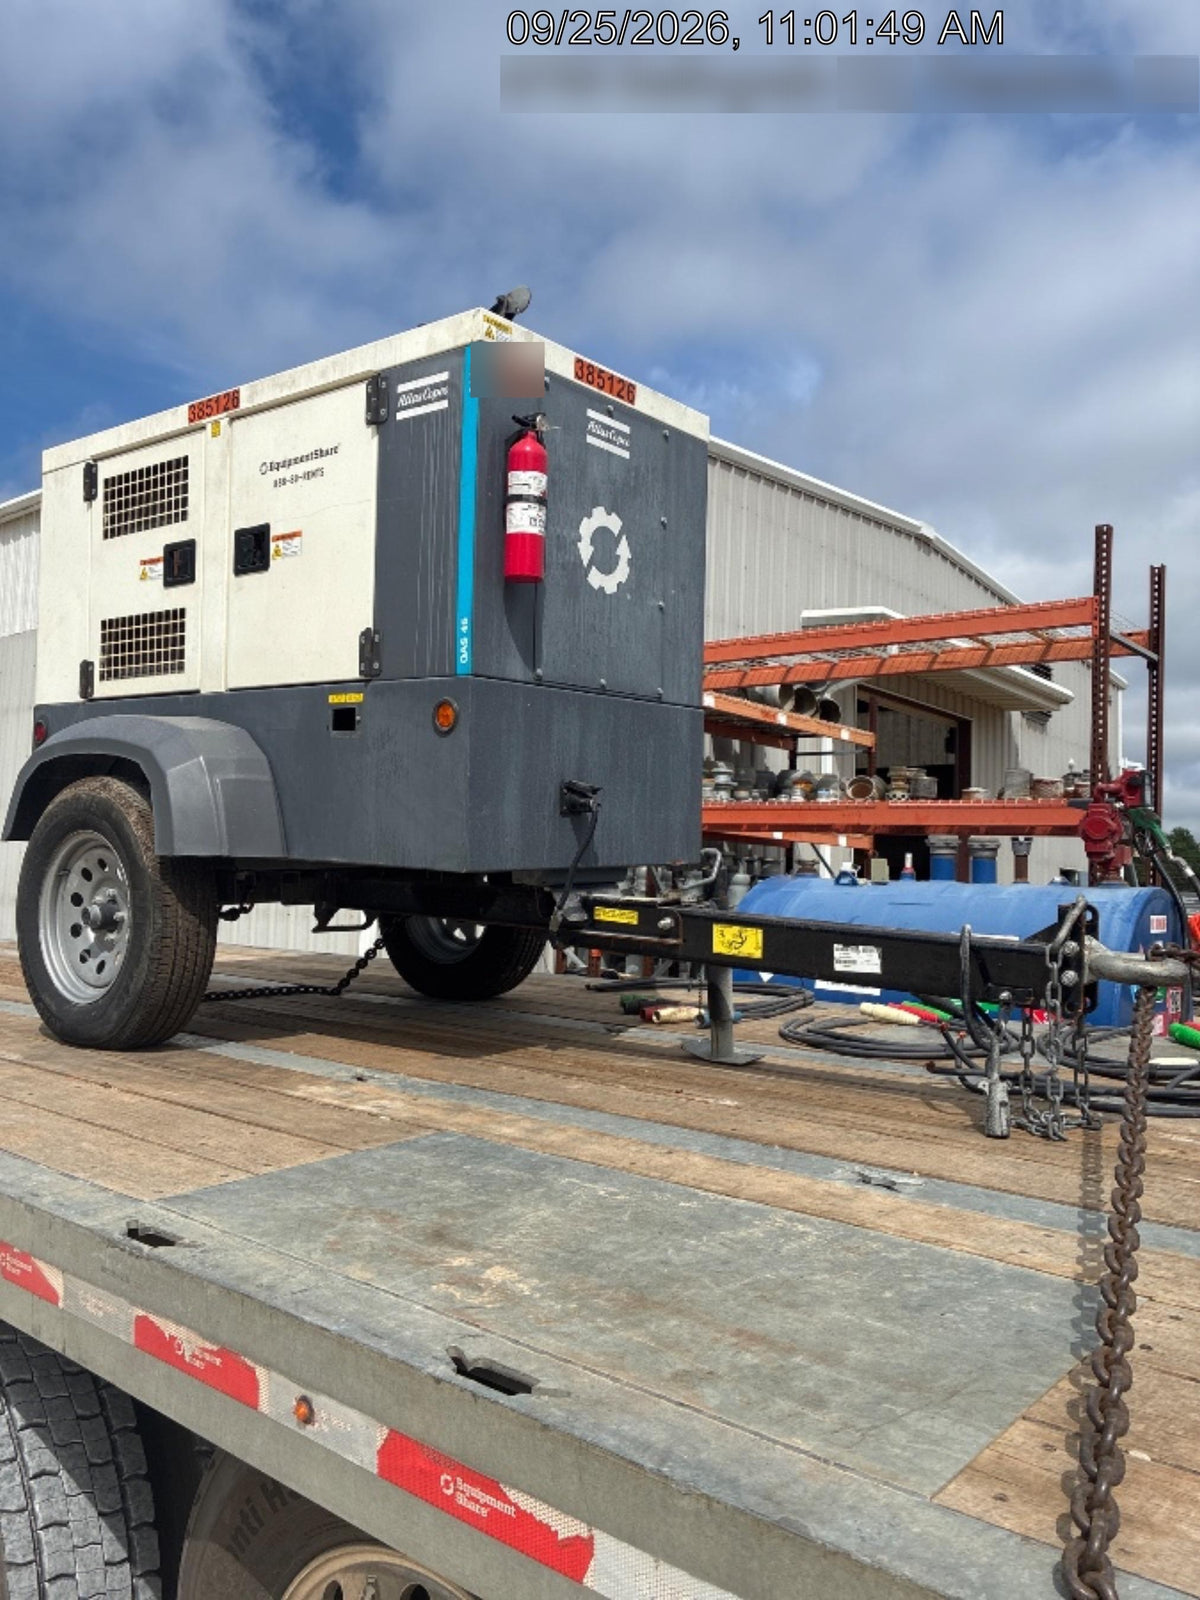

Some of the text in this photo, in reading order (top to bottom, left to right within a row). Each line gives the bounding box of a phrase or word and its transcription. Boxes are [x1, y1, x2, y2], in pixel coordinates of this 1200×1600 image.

[574, 357, 637, 406] 385126
[188, 389, 240, 423] 385126
[455, 1491, 488, 1518] Share
[456, 1476, 516, 1518] Equipment
